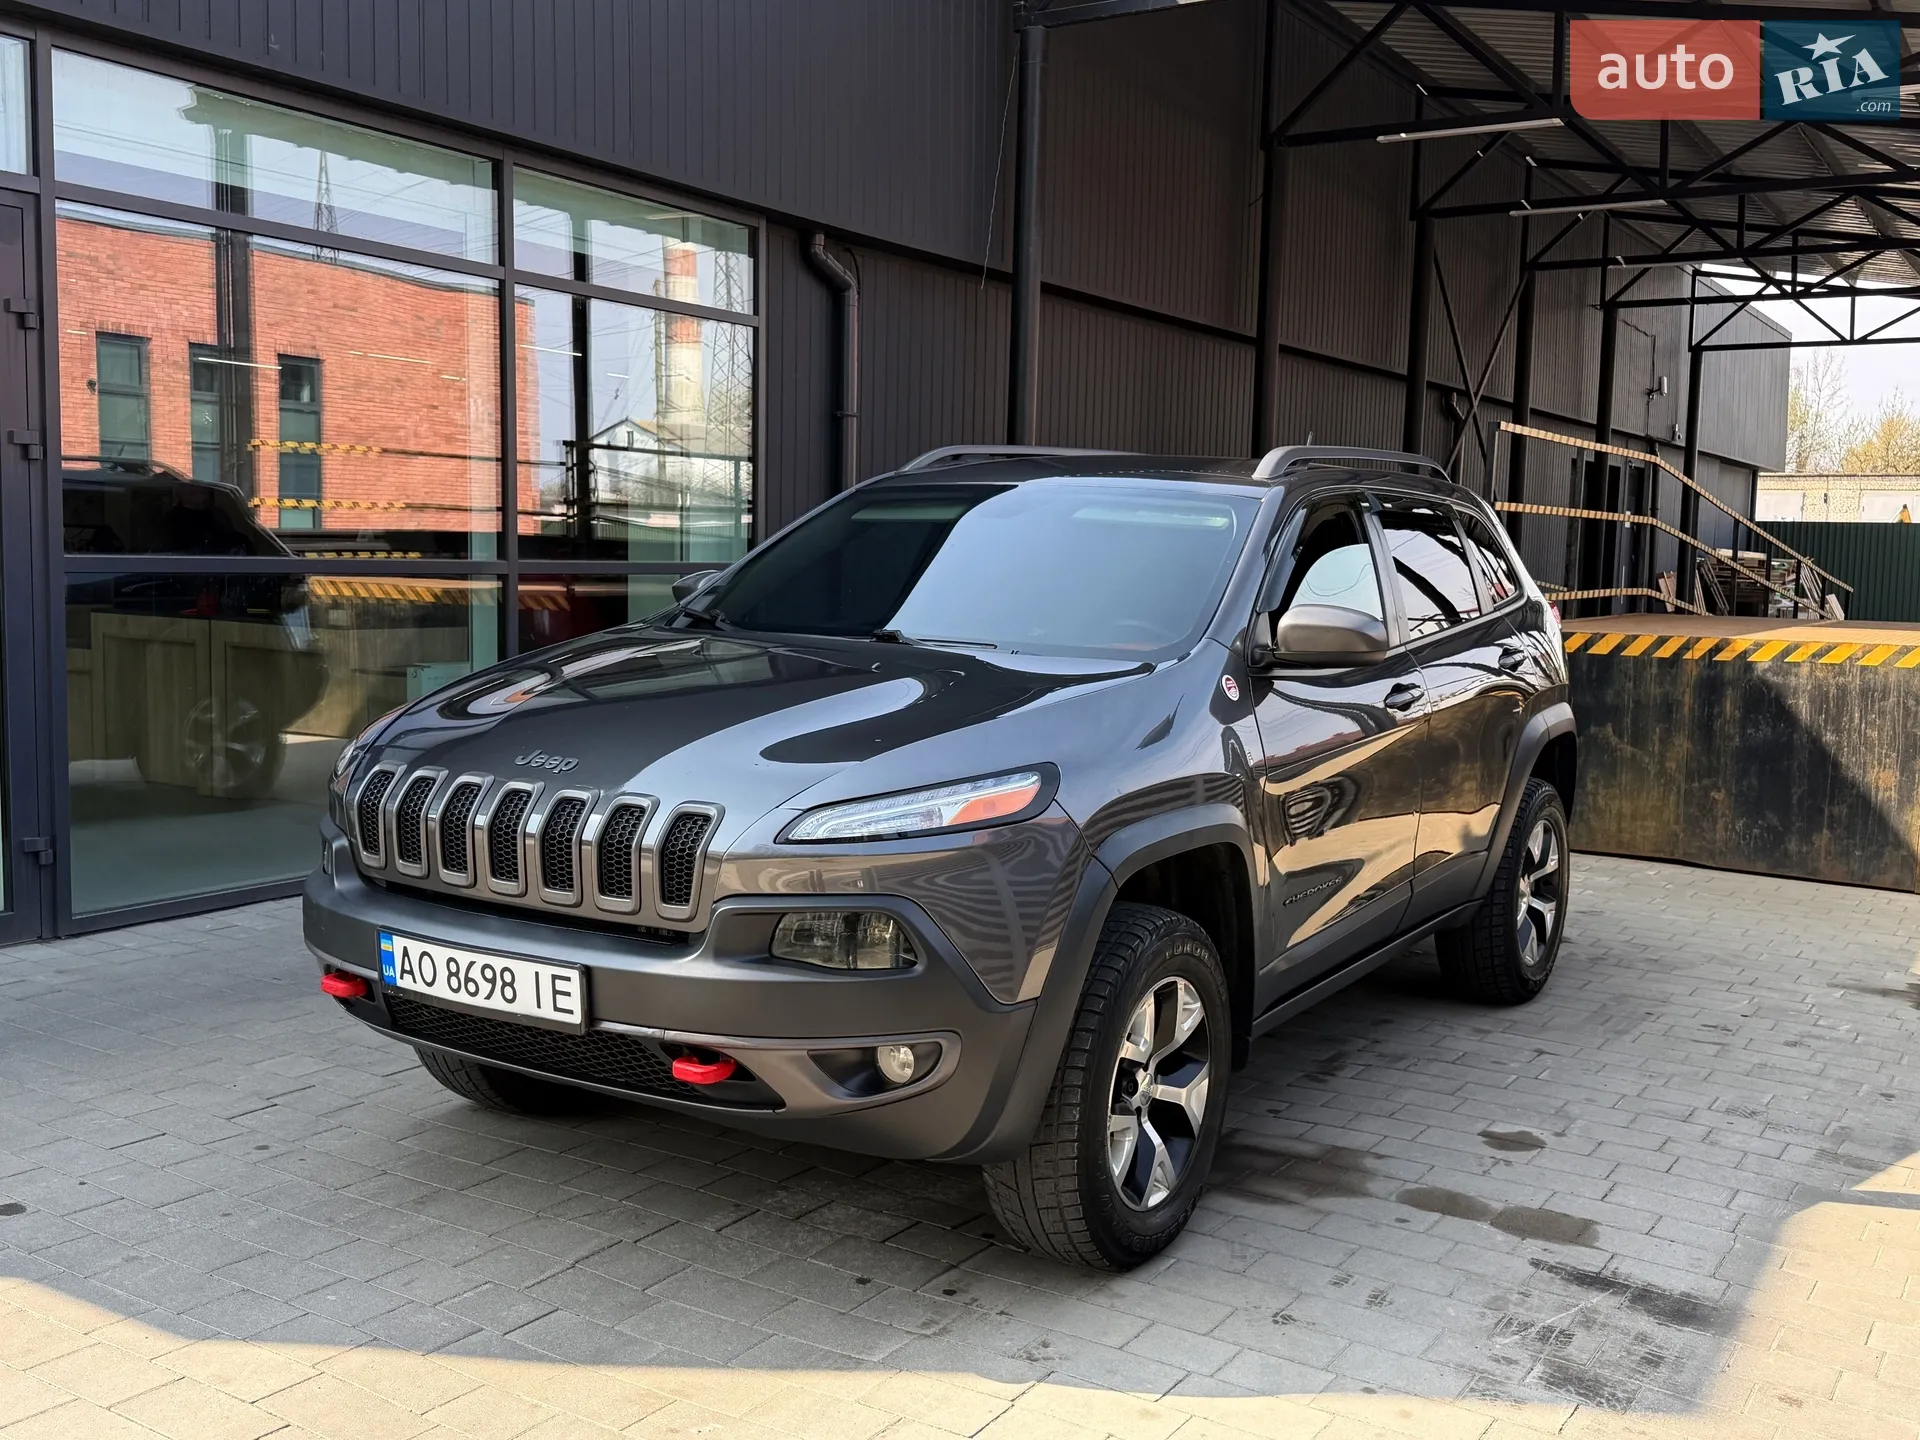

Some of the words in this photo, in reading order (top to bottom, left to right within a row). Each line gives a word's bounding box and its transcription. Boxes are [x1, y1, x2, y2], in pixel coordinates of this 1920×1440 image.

[514, 749, 579, 774] Jeep
[382, 964, 396, 978] UA
[399, 945, 437, 988] AO
[445, 956, 518, 1005] 8698
[534, 970, 575, 1016] IE
